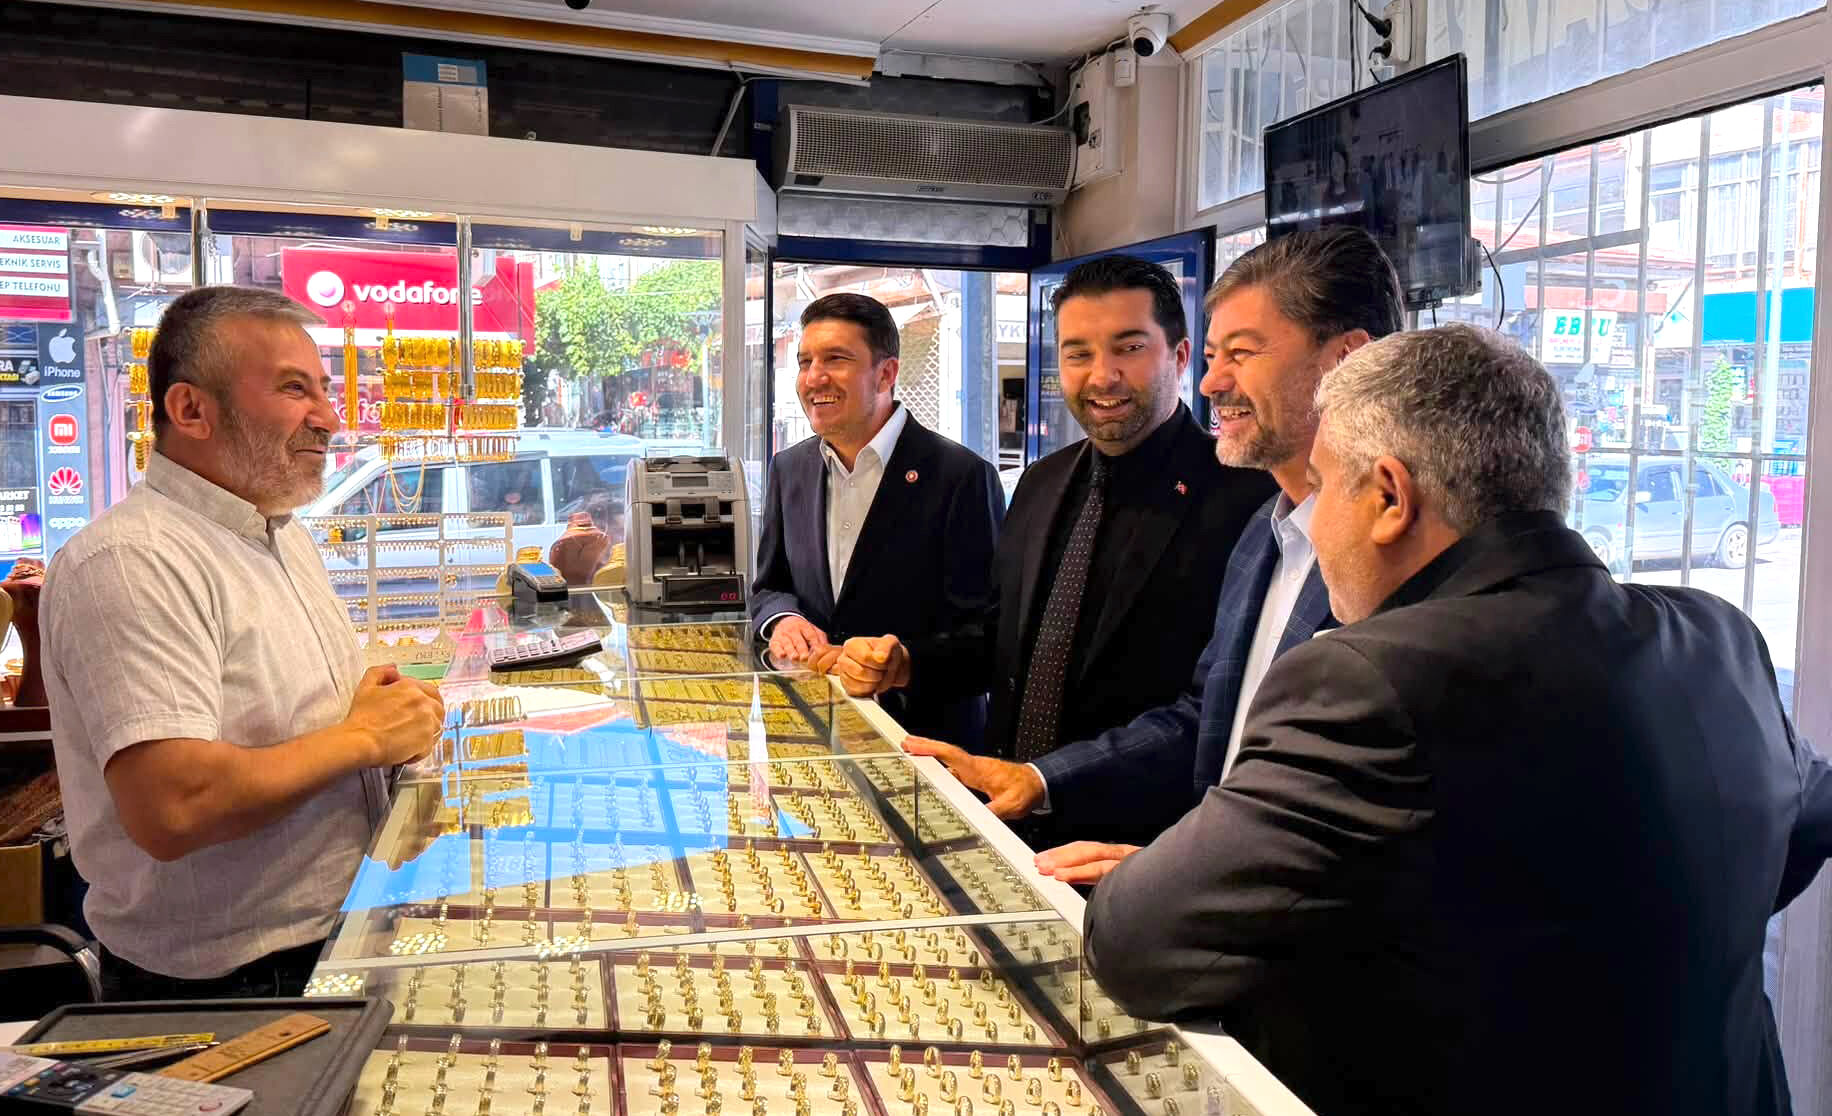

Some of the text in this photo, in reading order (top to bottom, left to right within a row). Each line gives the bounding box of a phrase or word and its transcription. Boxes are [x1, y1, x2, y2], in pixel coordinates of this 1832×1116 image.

[13, 234, 60, 245] AKSESUAR
[353, 280, 483, 305] vodafone
[44, 366, 81, 378] iPhone
